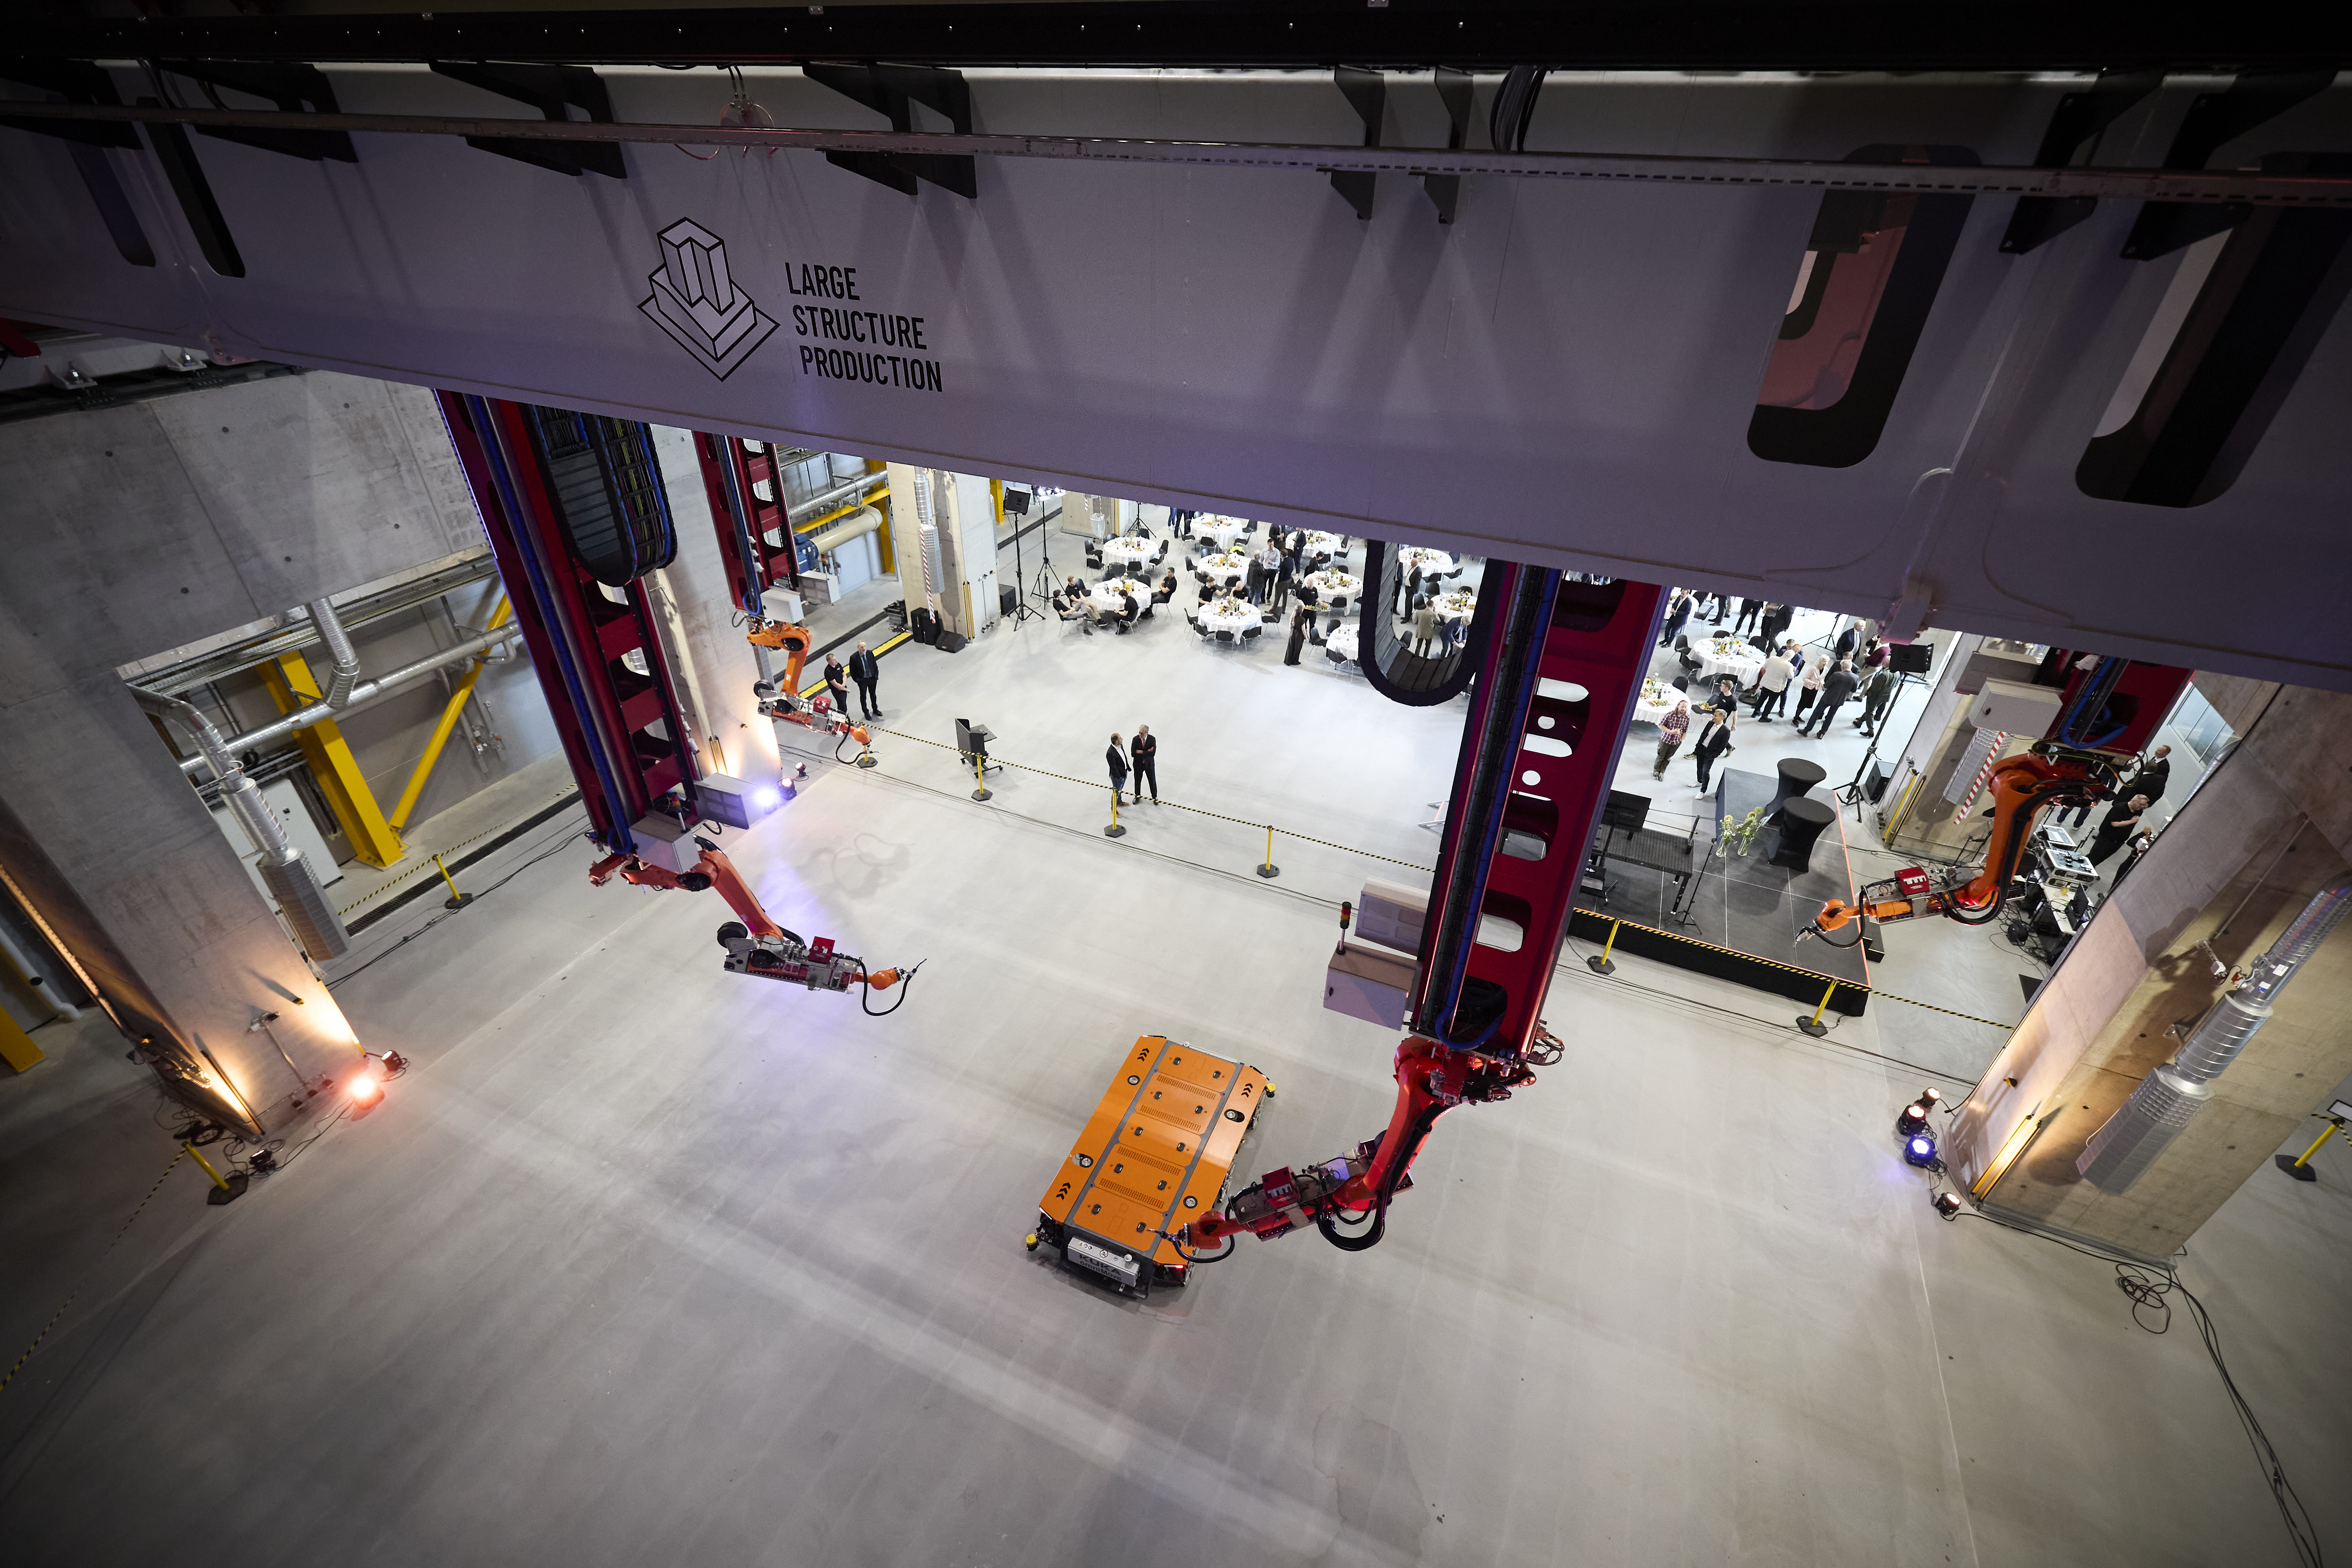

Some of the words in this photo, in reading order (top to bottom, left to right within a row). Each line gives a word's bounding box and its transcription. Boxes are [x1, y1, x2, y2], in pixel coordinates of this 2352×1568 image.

[785, 262, 860, 300] LARGE
[793, 305, 927, 350] STRUCTURE
[800, 345, 942, 392] PRODUCTION
[1079, 1254, 1121, 1276] KUKA
[1080, 1261, 1121, 1281] omniMove
